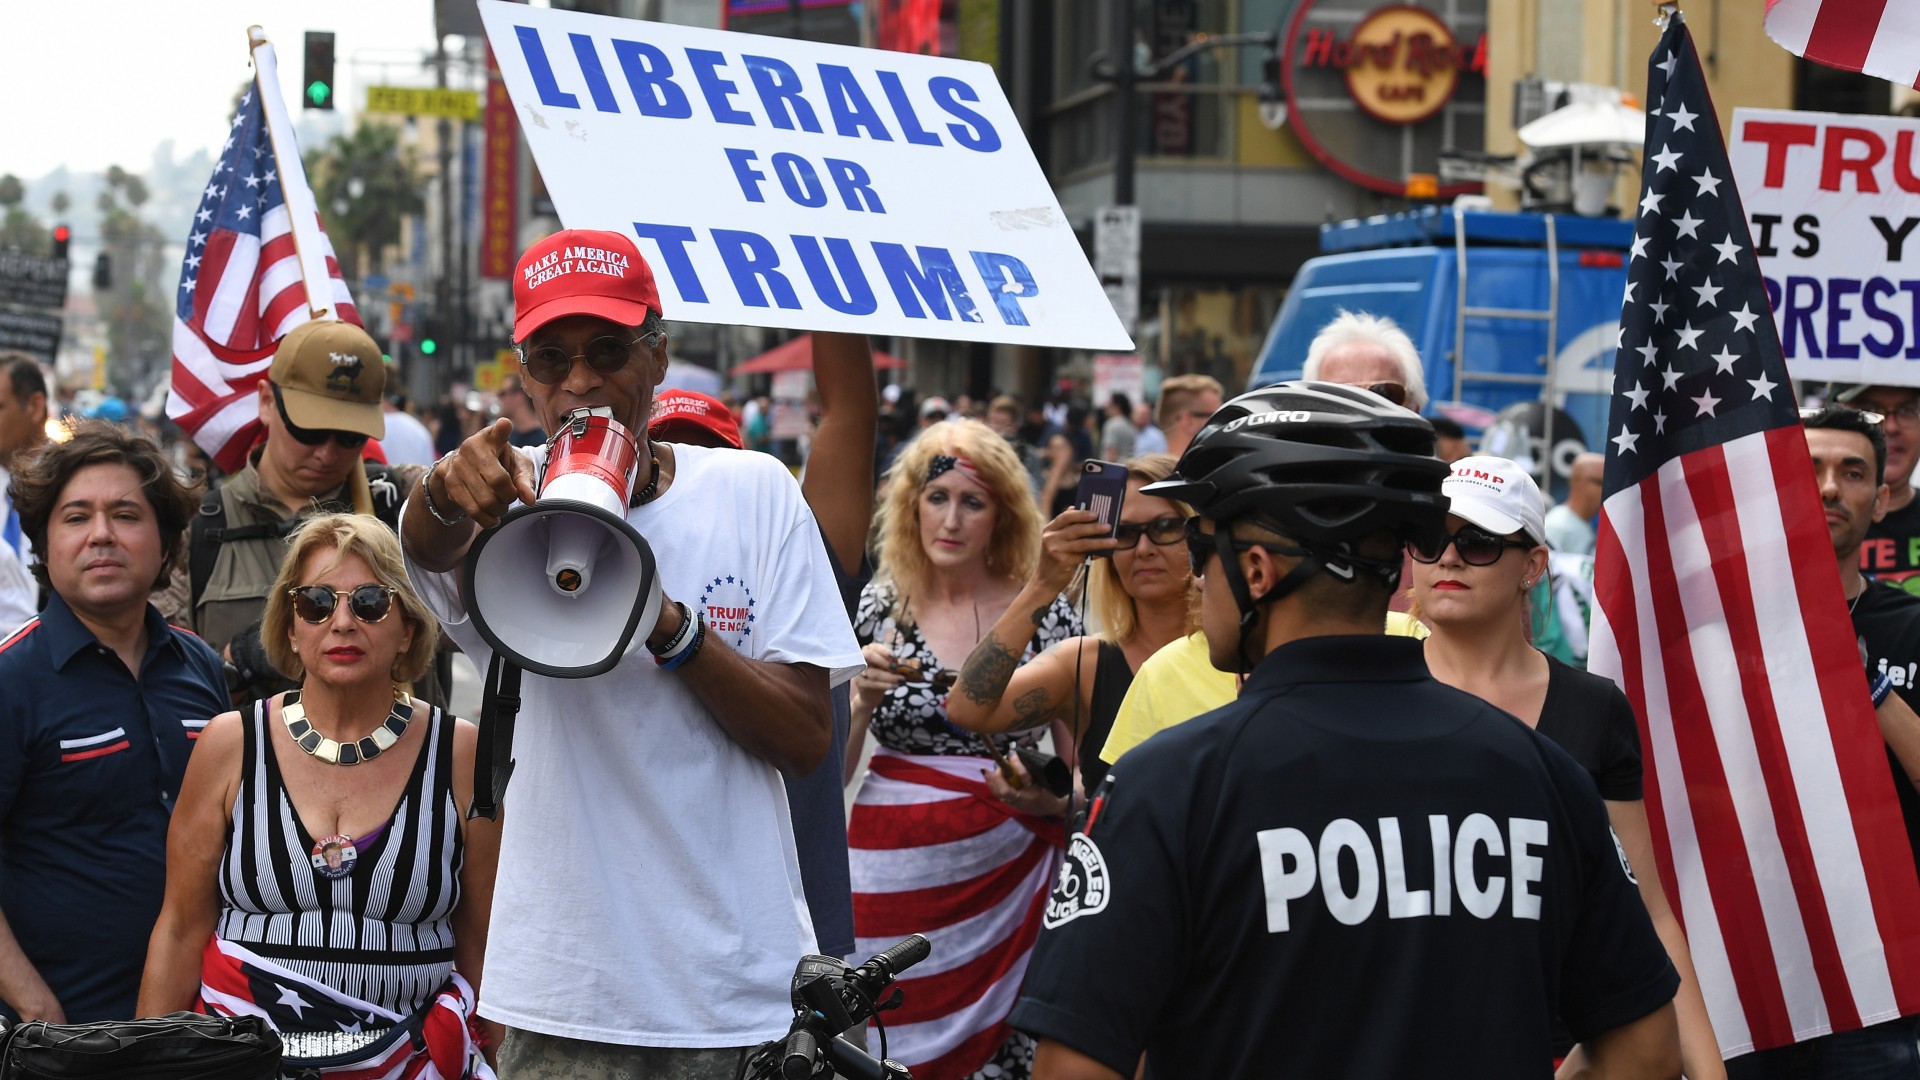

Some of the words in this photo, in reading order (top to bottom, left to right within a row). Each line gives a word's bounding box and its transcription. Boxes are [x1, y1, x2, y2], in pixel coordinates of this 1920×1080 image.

[1304, 27, 1401, 70] Hard
[1404, 31, 1490, 80] Rock
[514, 25, 1002, 152] LIBERALS
[725, 148, 885, 214] FOR
[1751, 213, 1820, 258] IS
[524, 250, 558, 280] MAKE
[563, 246, 630, 268] AMERICA
[528, 260, 573, 289] GREAT
[575, 260, 624, 279] AGAIN
[634, 222, 1039, 326] TRUMP
[668, 397, 711, 410] AMERICA
[677, 405, 707, 416] AGAIN
[1247, 410, 1311, 426] GIRO
[1449, 468, 1505, 484] UMP
[1484, 483, 1501, 493] AGAIN
[706, 605, 750, 620] TRUMP
[710, 621, 746, 632] PENCE
[316, 836, 346, 850] TRUMP
[326, 860, 354, 878] President
[1067, 840, 1104, 907] NGELES
[1256, 813, 1549, 933] POLICE
[1046, 896, 1080, 919] LICE
